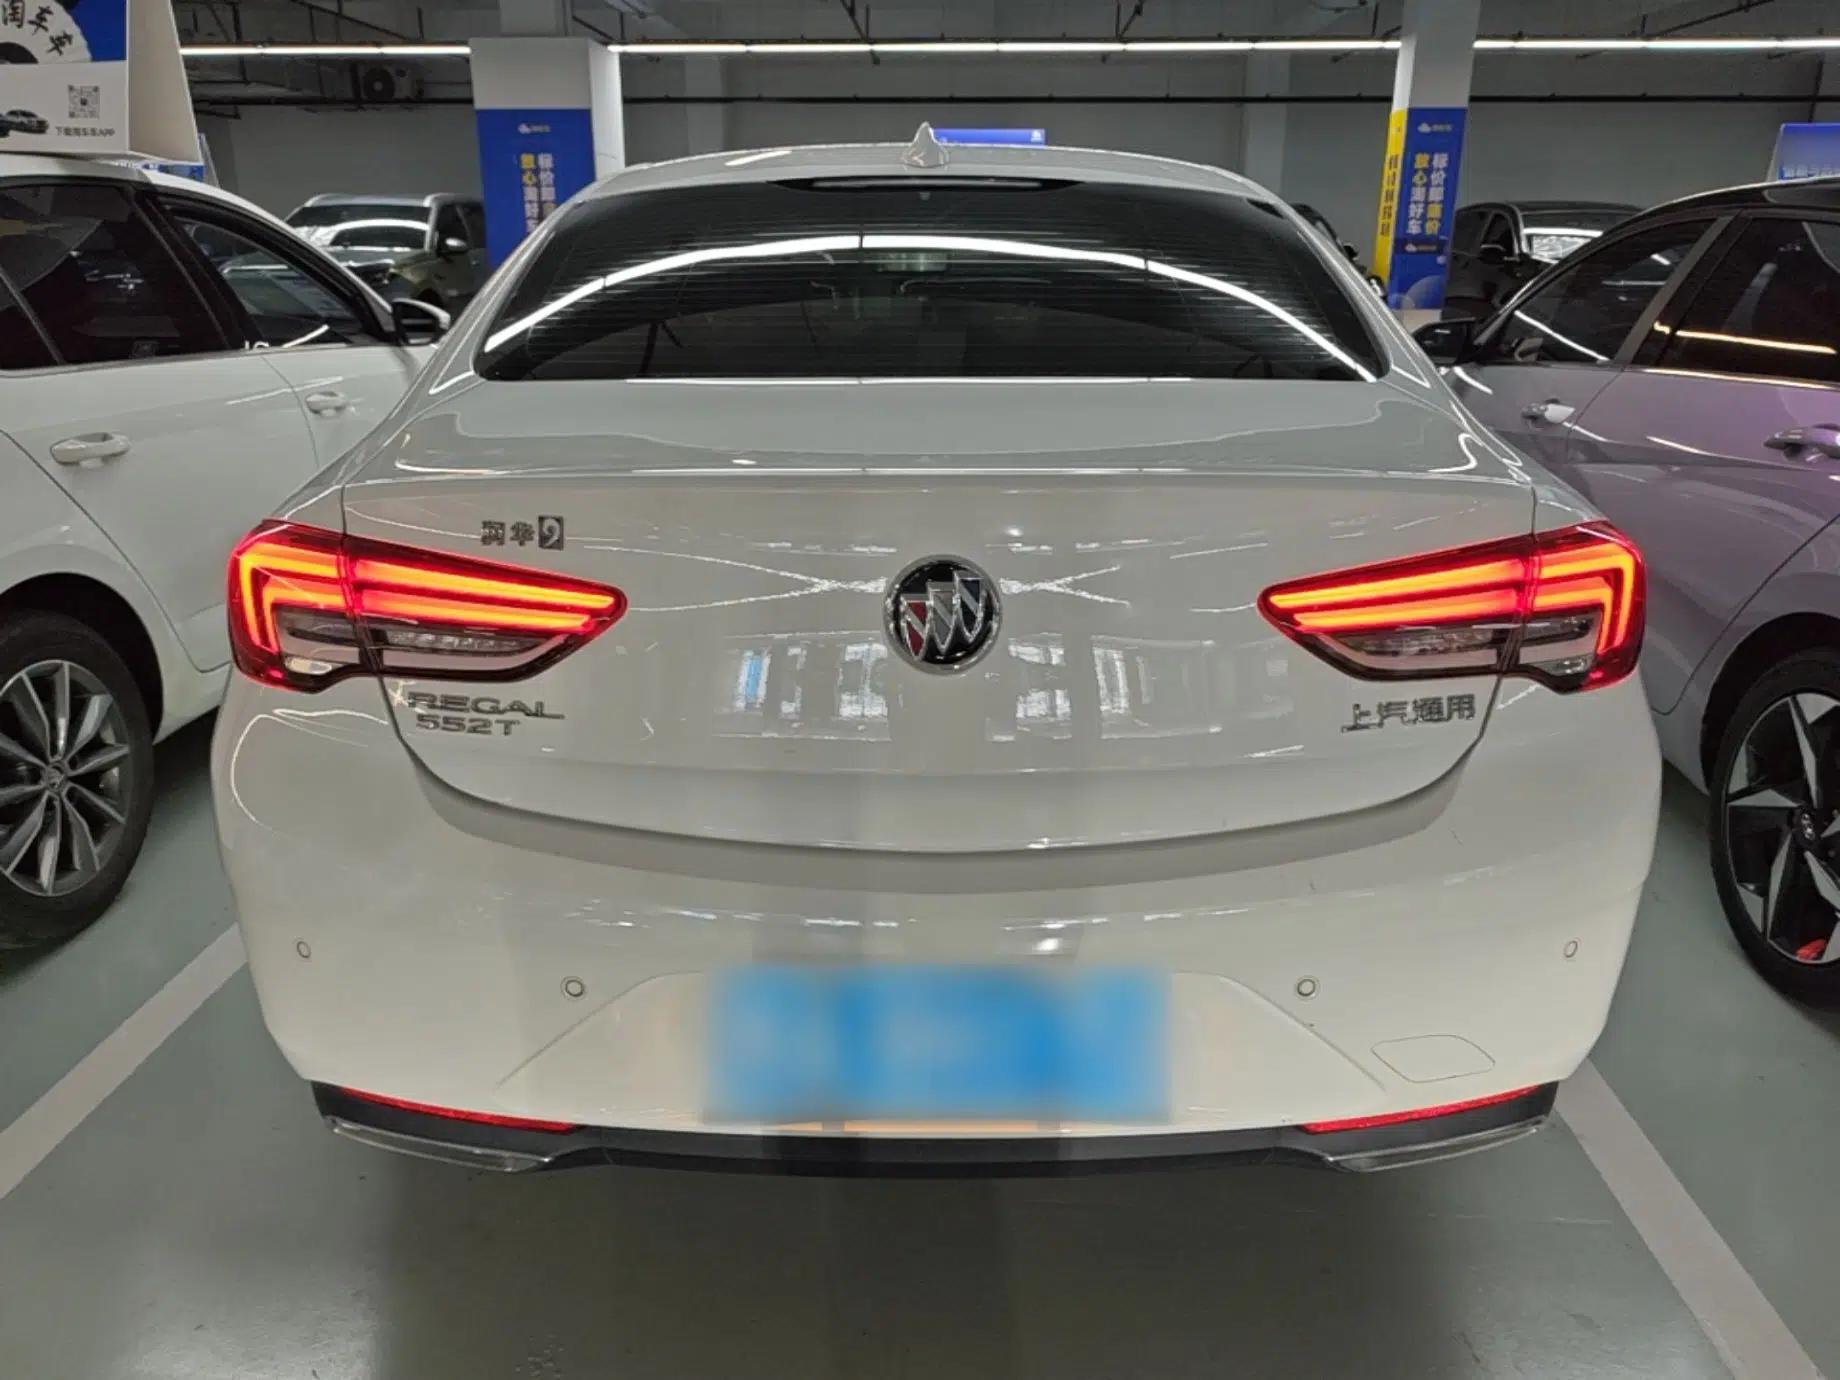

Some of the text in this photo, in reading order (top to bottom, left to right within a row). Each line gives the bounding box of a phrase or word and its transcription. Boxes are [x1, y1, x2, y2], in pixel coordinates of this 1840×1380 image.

[407, 691, 566, 720] REGAL
[1341, 693, 1476, 733] 上汽通用
[416, 713, 521, 737] 552T
